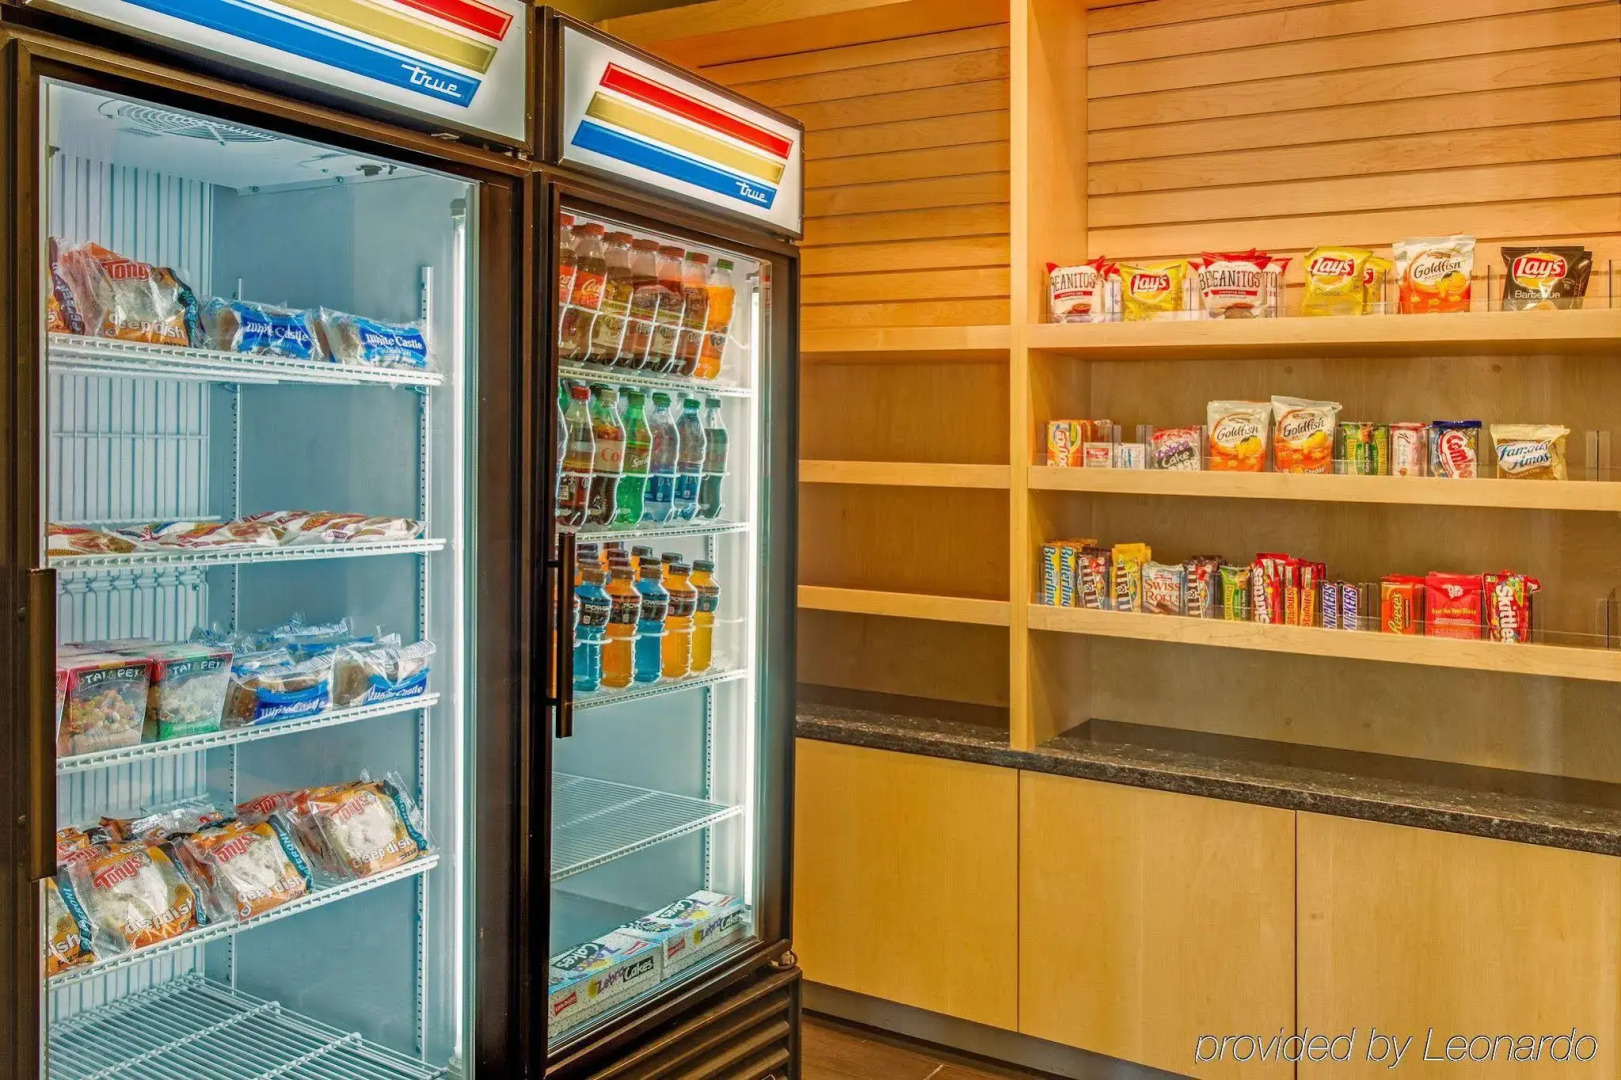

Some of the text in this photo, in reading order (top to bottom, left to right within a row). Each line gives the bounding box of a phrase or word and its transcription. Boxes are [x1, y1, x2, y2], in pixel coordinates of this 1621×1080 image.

[1414, 260, 1461, 279] Goldfish
[1514, 290, 1560, 299] Barbeue
[152, 320, 187, 340] dish
[366, 333, 423, 350] White Castle
[1217, 424, 1259, 441] Goldfish
[1283, 417, 1326, 438] Goldfish
[1162, 451, 1190, 468] Cake
[1344, 586, 1357, 630] NICKERS
[1495, 585, 1517, 644] Skittles
[85, 668, 138, 684] TAI PEI
[173, 661, 220, 675] TAI PEI
[352, 835, 414, 868] deep dish
[92, 856, 143, 891] Tony's
[274, 875, 305, 893] dish
[594, 960, 653, 994] Zebra Cakes
